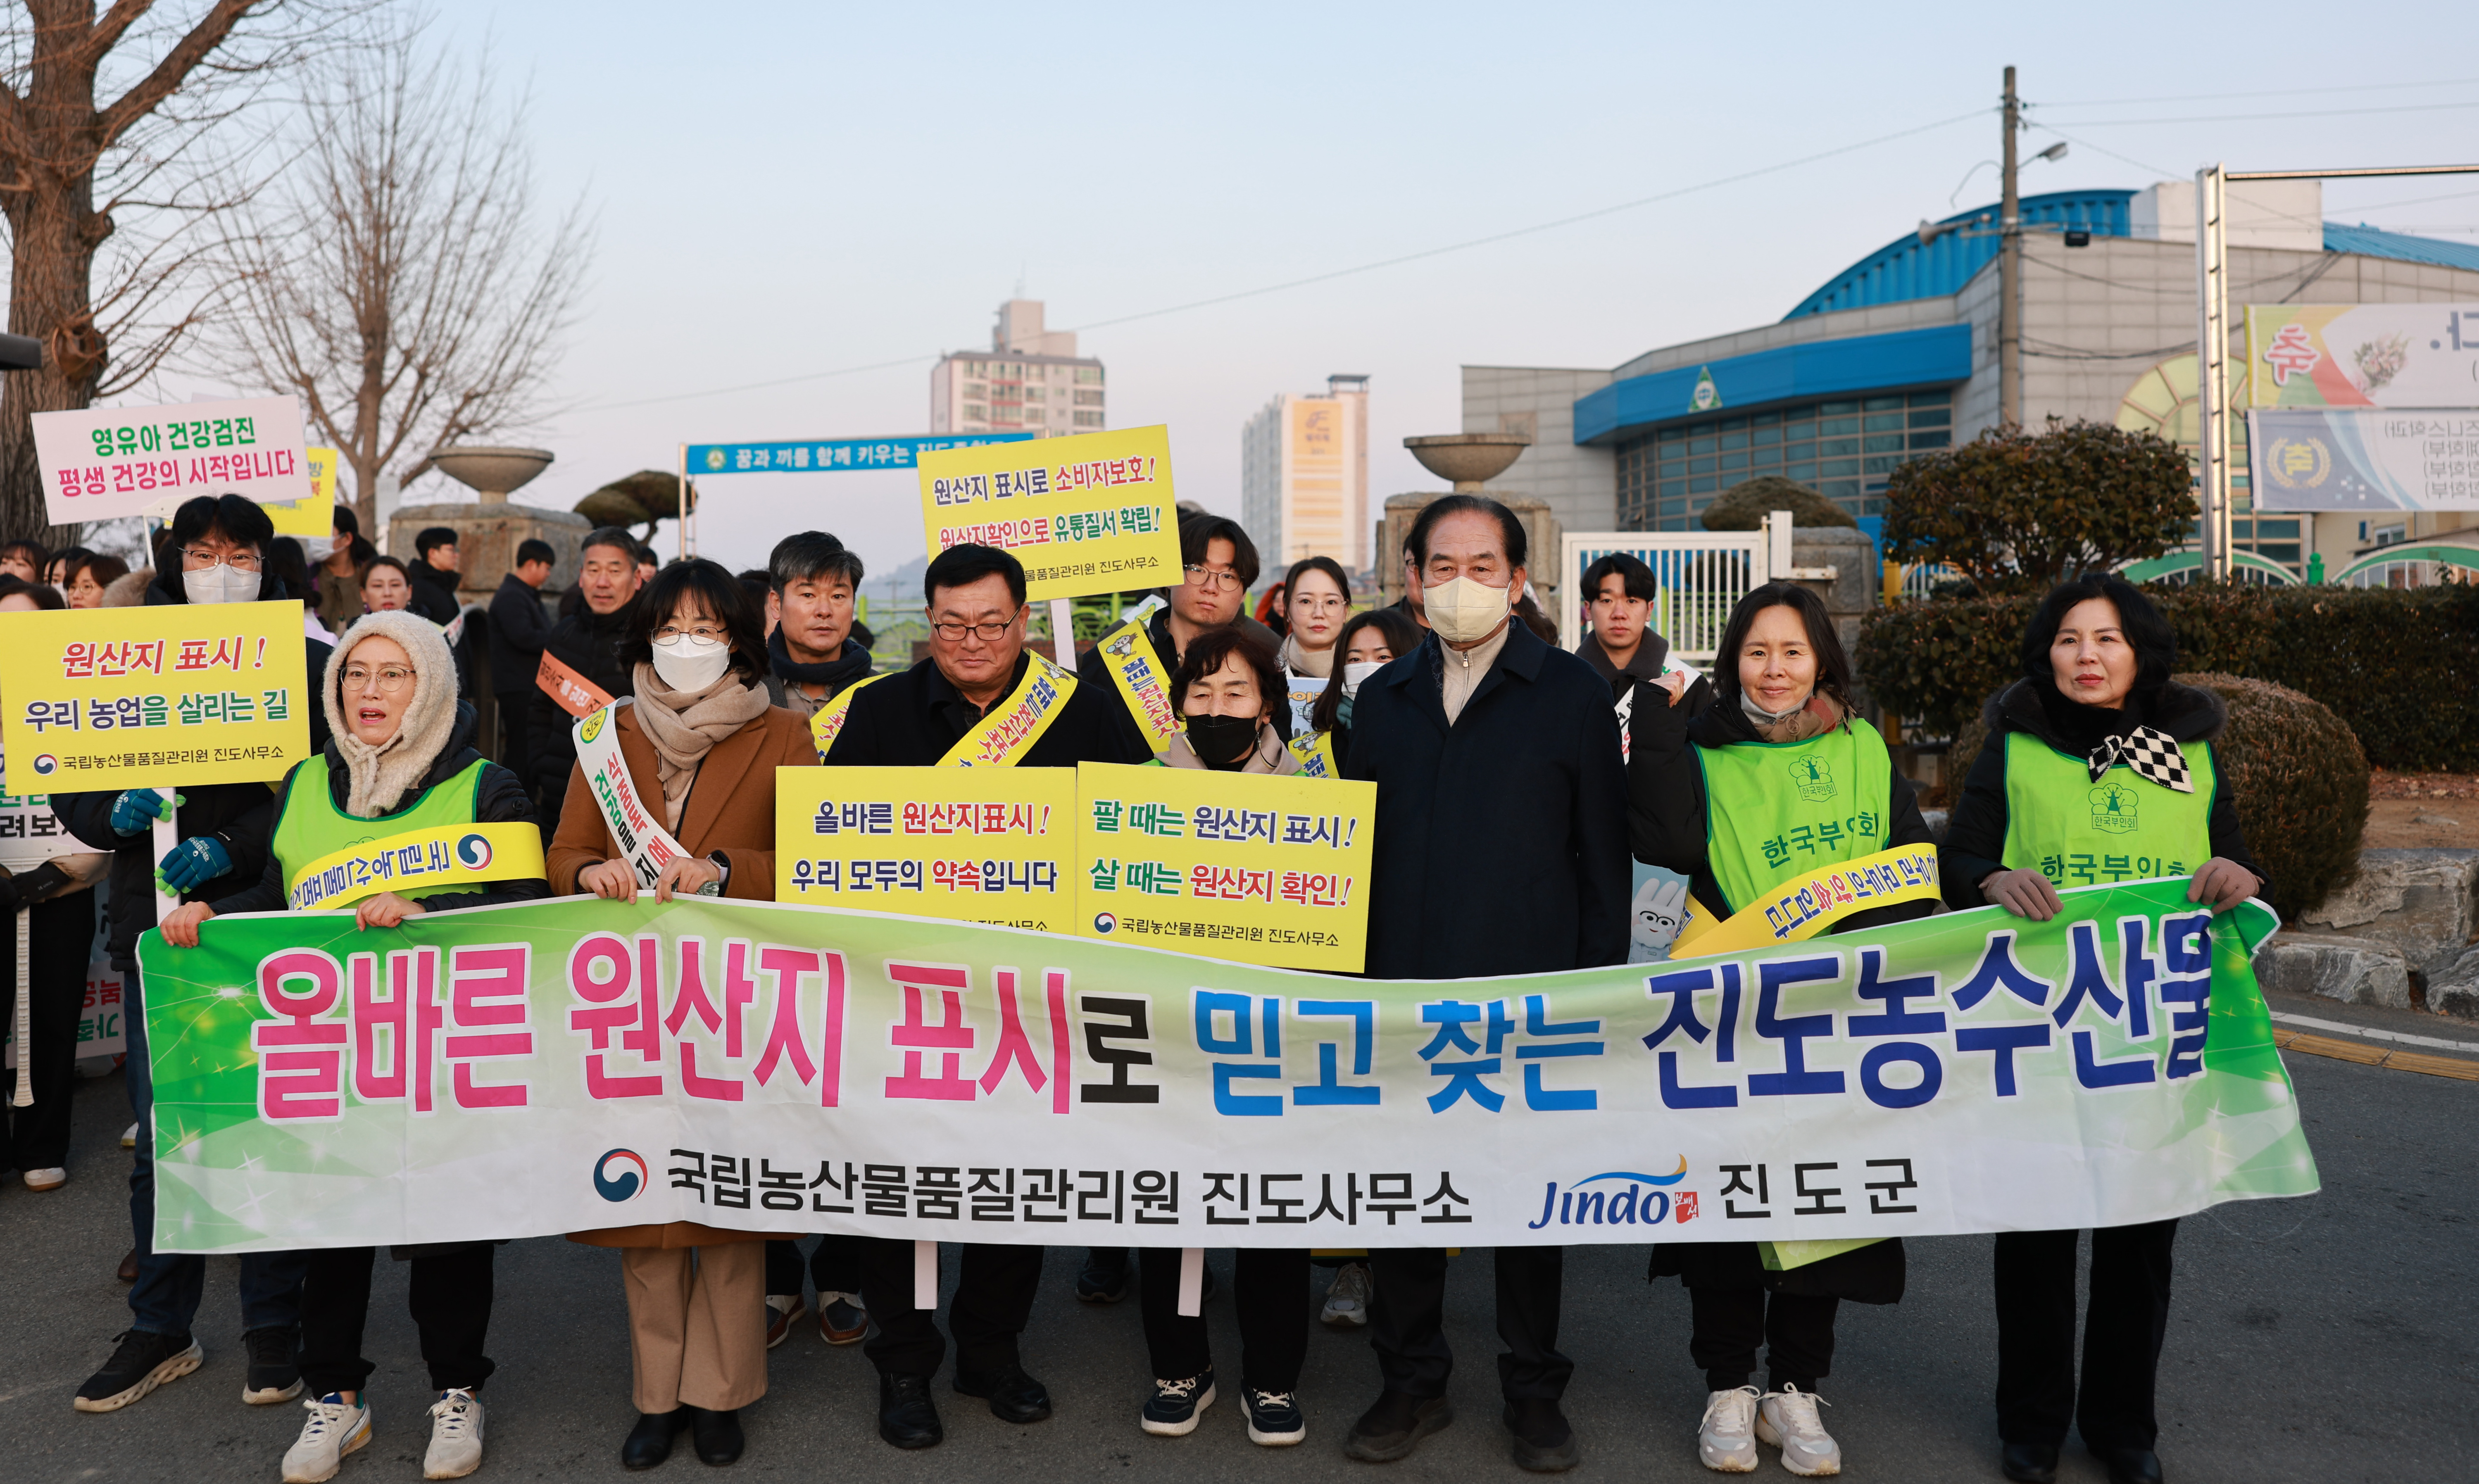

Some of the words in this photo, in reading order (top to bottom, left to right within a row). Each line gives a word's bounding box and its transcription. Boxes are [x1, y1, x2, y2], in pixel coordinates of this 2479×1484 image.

[91, 425, 161, 457] 영유아
[167, 416, 256, 451] 건강검진
[735, 448, 771, 469] 꿈과
[776, 446, 810, 468] 끼를
[816, 446, 851, 466] 함께
[856, 444, 910, 464] 키우는
[58, 467, 105, 497] 평생
[112, 459, 181, 492] 건강의
[189, 449, 295, 484] 시작입니다
[934, 475, 988, 506] 원산지
[994, 469, 1049, 498] 표시로
[1056, 455, 1156, 492] 소비자보호!
[940, 518, 1050, 550] 원산지확인으로
[1054, 510, 1117, 542] 유통질서
[1120, 506, 1161, 534] 확립!
[1100, 556, 1159, 573] 진도사무소
[62, 640, 165, 678] 원산지
[25, 699, 79, 732] 우리
[89, 694, 169, 730] 농업을
[177, 691, 255, 725] 살리는
[263, 688, 288, 720] 길
[63, 750, 207, 770] 국립농산물품질관리원
[214, 746, 283, 761] 진도사무소
[1802, 781, 1836, 797] 한국부인회
[814, 801, 893, 834] 올바른
[1093, 800, 1123, 833] 팔
[1130, 803, 1185, 836] 때는
[1193, 806, 1276, 844] 원산지
[1282, 816, 1356, 848] 표시!
[2095, 816, 2135, 828] 한국부인회
[792, 860, 840, 892] 우리
[849, 860, 923, 892] 모두의
[932, 860, 1057, 892] 약속입니다
[1090, 859, 1120, 891] 살
[1126, 862, 1182, 895] 때는
[1190, 865, 1273, 903] 원산지
[1281, 871, 1353, 906] 확인!
[1763, 875, 1854, 939] 약속입니다
[1122, 918, 1263, 942] 국립농산물품질관리원
[1269, 929, 1339, 947] 진도사무소
[258, 951, 533, 1119] 올바른
[571, 937, 844, 1107] 원산지
[885, 963, 1159, 1115] 표시로
[1194, 990, 1380, 1117] 믿고
[1418, 995, 1604, 1114] 찾는
[1644, 914, 2213, 1110] 진도농수산물
[668, 1148, 1179, 1224] 국립농산물품질관리원
[1201, 1171, 1473, 1225] 진도사무소
[1528, 1182, 1669, 1229] Jindo
